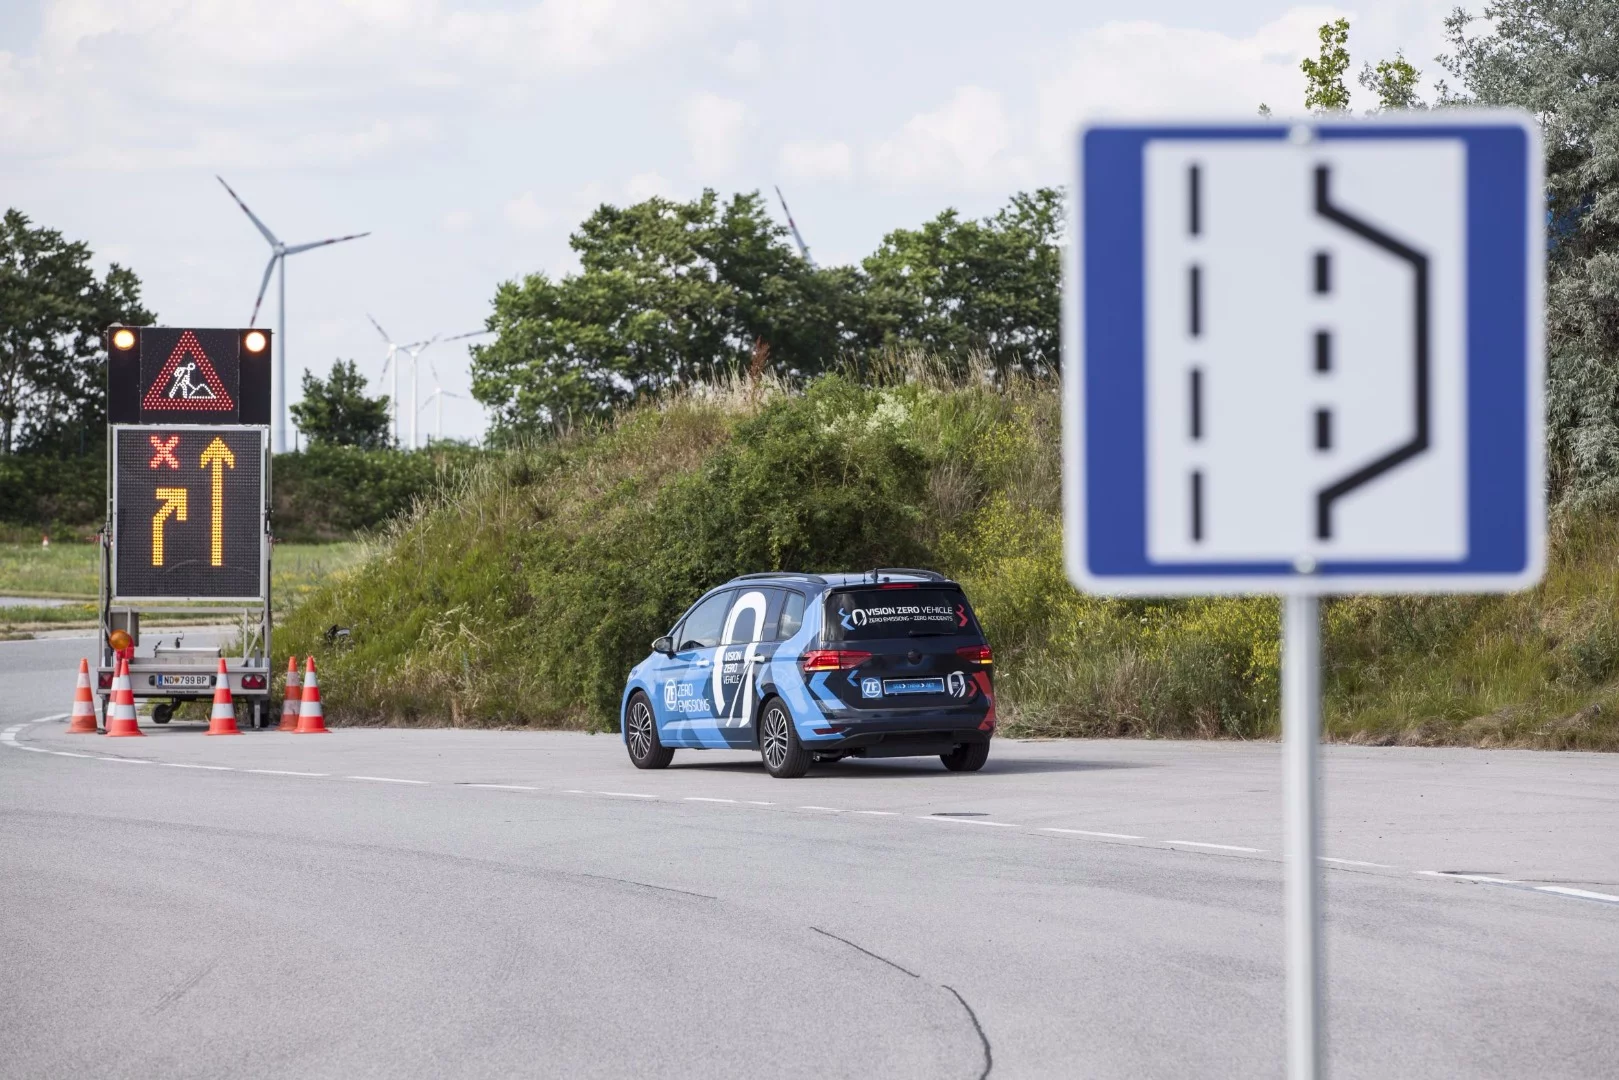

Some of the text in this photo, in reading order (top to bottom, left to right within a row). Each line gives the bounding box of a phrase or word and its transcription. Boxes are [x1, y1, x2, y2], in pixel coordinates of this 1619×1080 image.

[866, 606, 953, 616] VISION ZERO VEHICLE
[868, 616, 883, 624] ZERO
[725, 651, 743, 662] VISION
[723, 662, 739, 674] ZERO
[164, 676, 207, 685] ND 799 BP
[723, 674, 740, 685] VEHICLE
[677, 683, 694, 697] ZERO
[864, 680, 880, 694] ZF
[678, 698, 710, 712] EMISSIONS
